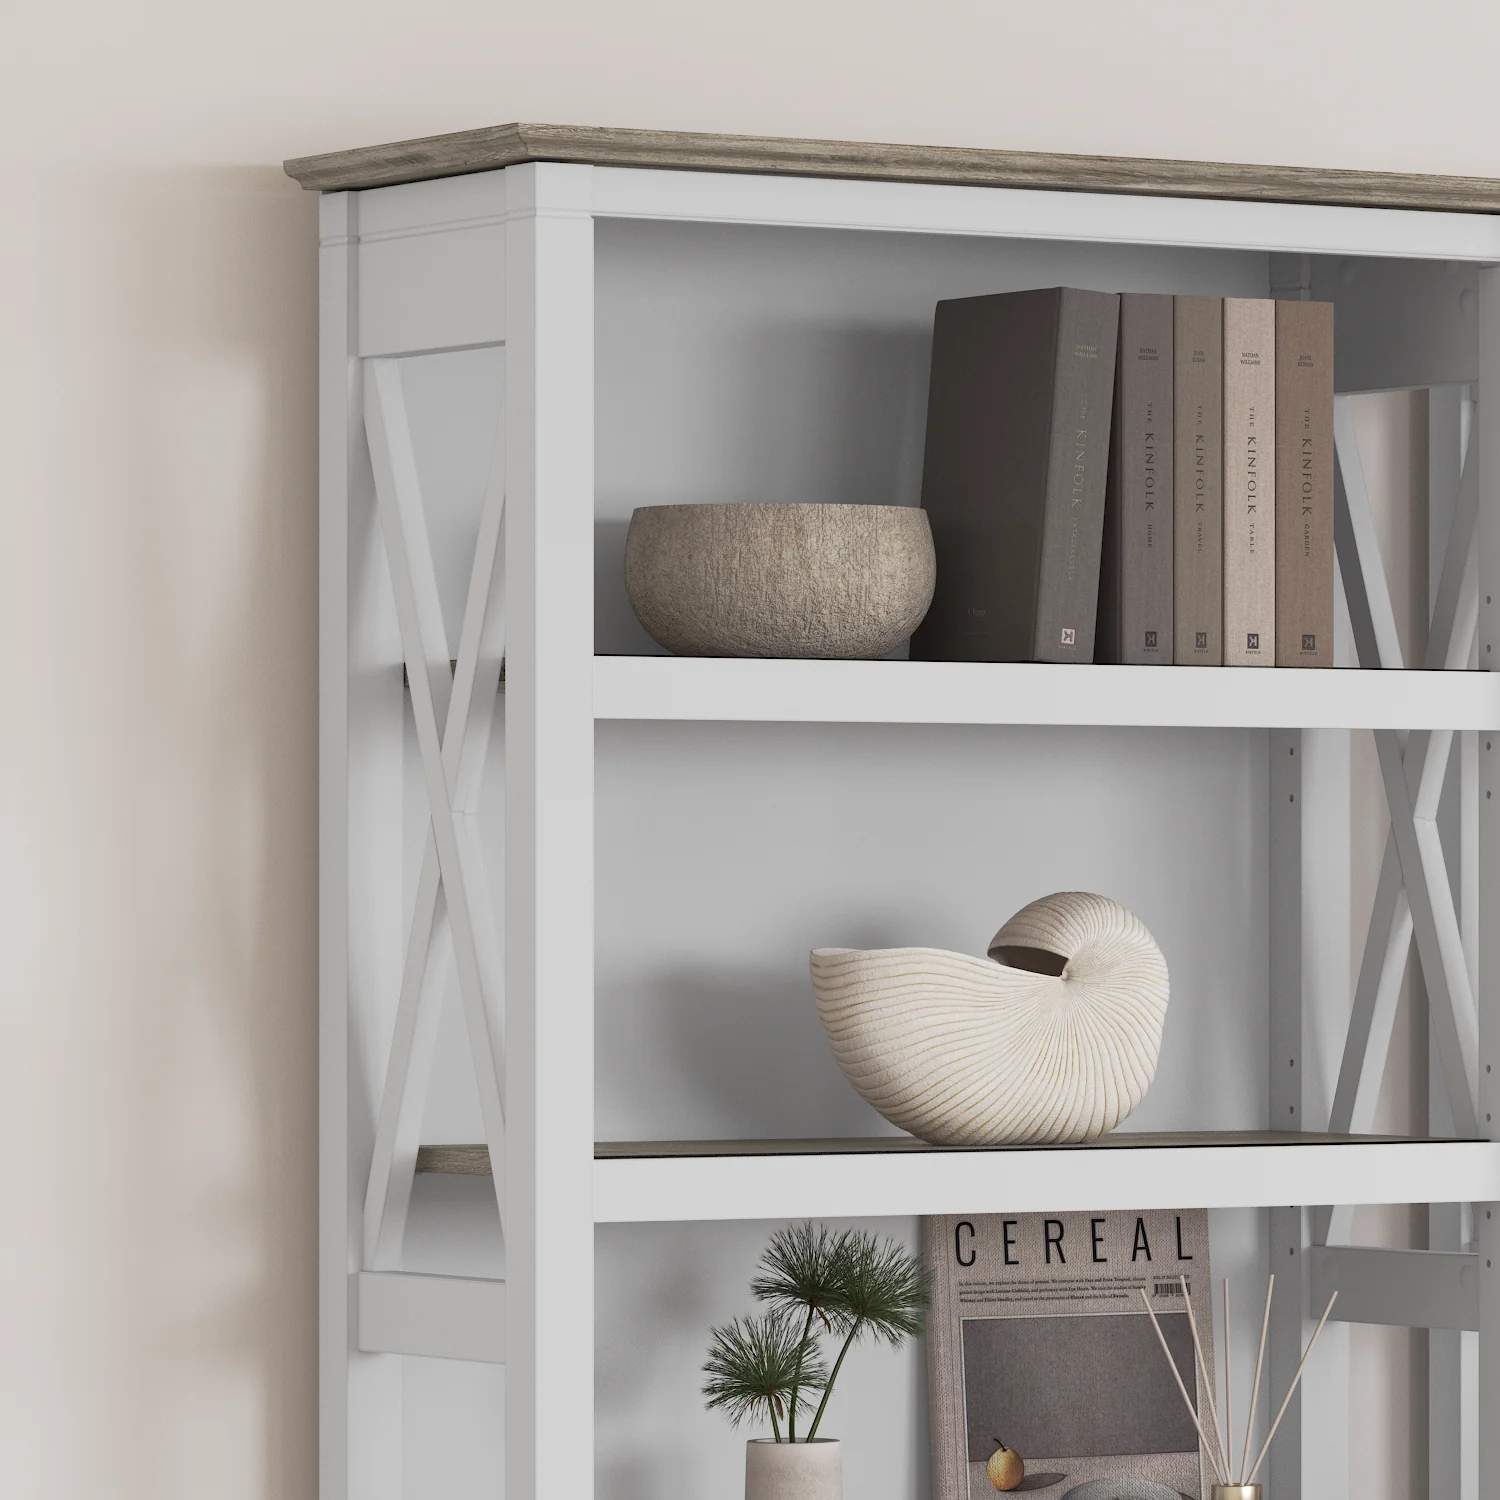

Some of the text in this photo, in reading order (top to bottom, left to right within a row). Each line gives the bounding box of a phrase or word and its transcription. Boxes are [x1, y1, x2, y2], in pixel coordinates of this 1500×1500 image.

[1071, 429, 1088, 508] KINFOLK
[1145, 433, 1154, 511] KINFOLK
[1195, 434, 1205, 513] KINFOLK
[1247, 436, 1257, 514] KINFOLK
[1302, 438, 1313, 516] KINFOLK
[955, 1216, 1193, 1267] CEREAL
